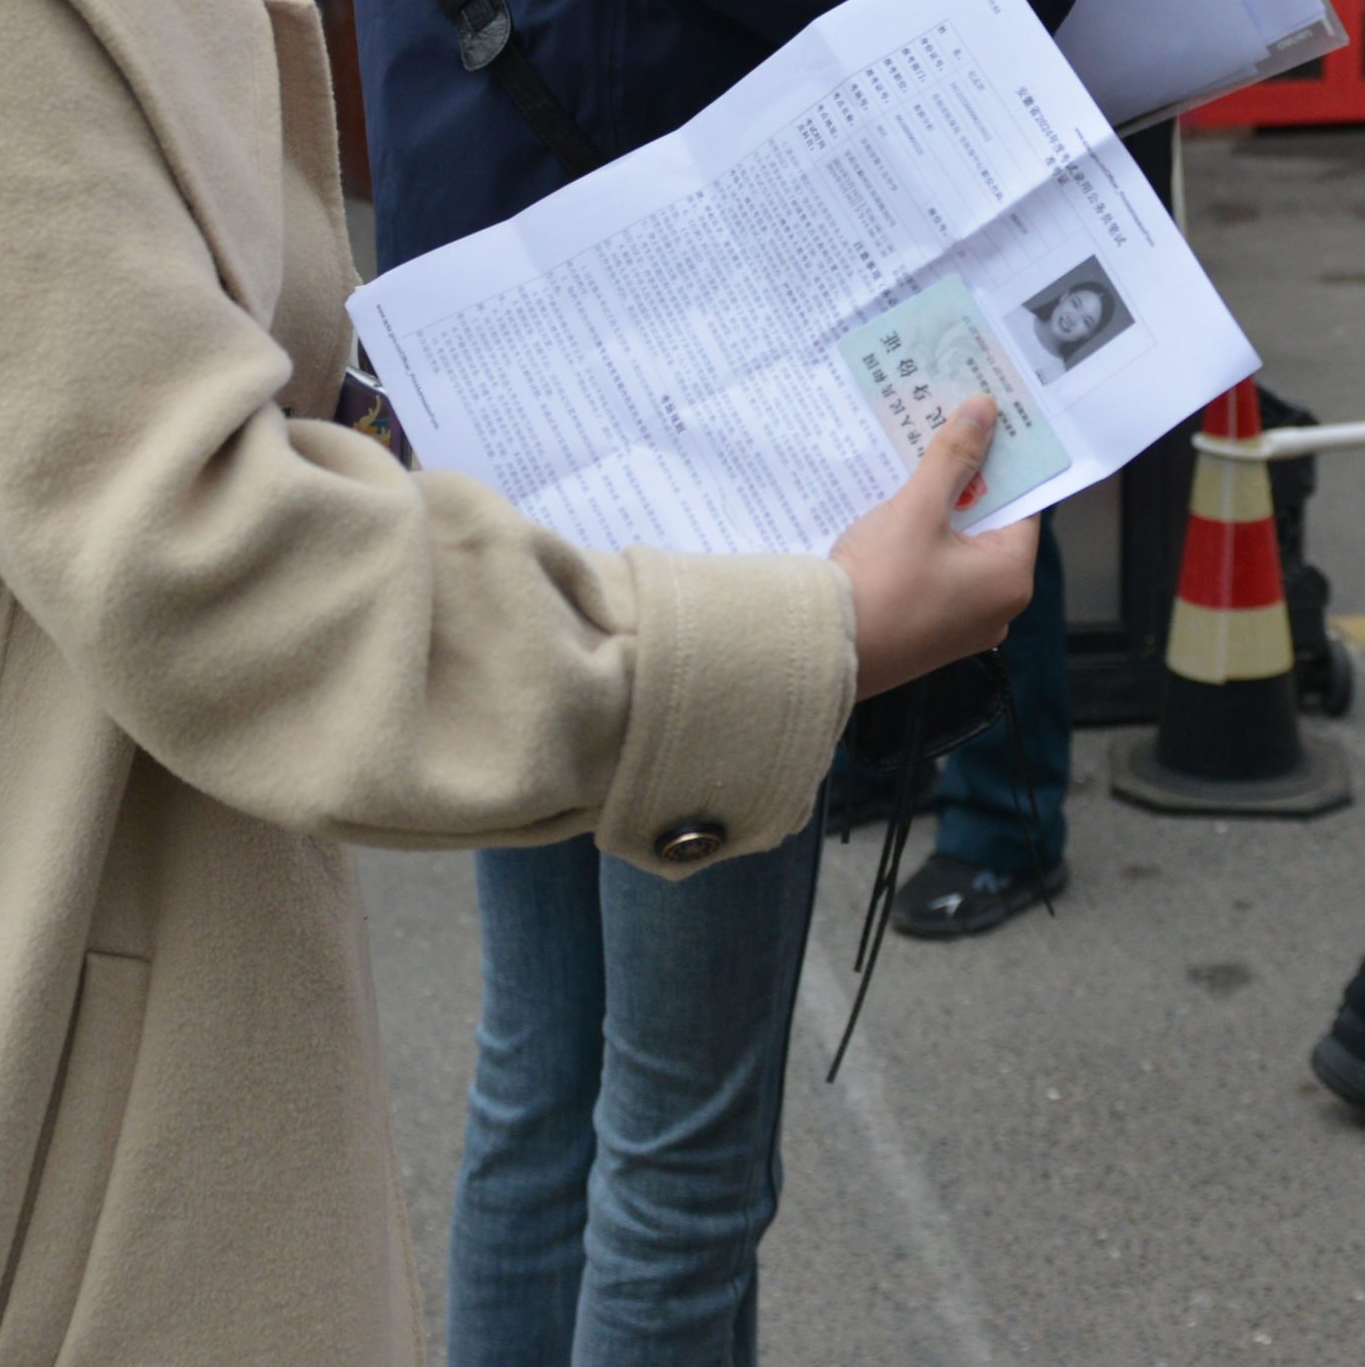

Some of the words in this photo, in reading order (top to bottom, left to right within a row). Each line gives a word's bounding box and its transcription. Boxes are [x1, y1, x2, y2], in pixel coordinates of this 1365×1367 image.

[1014, 84, 1128, 247] 安徽省2024年度考试录用公务员笔试
